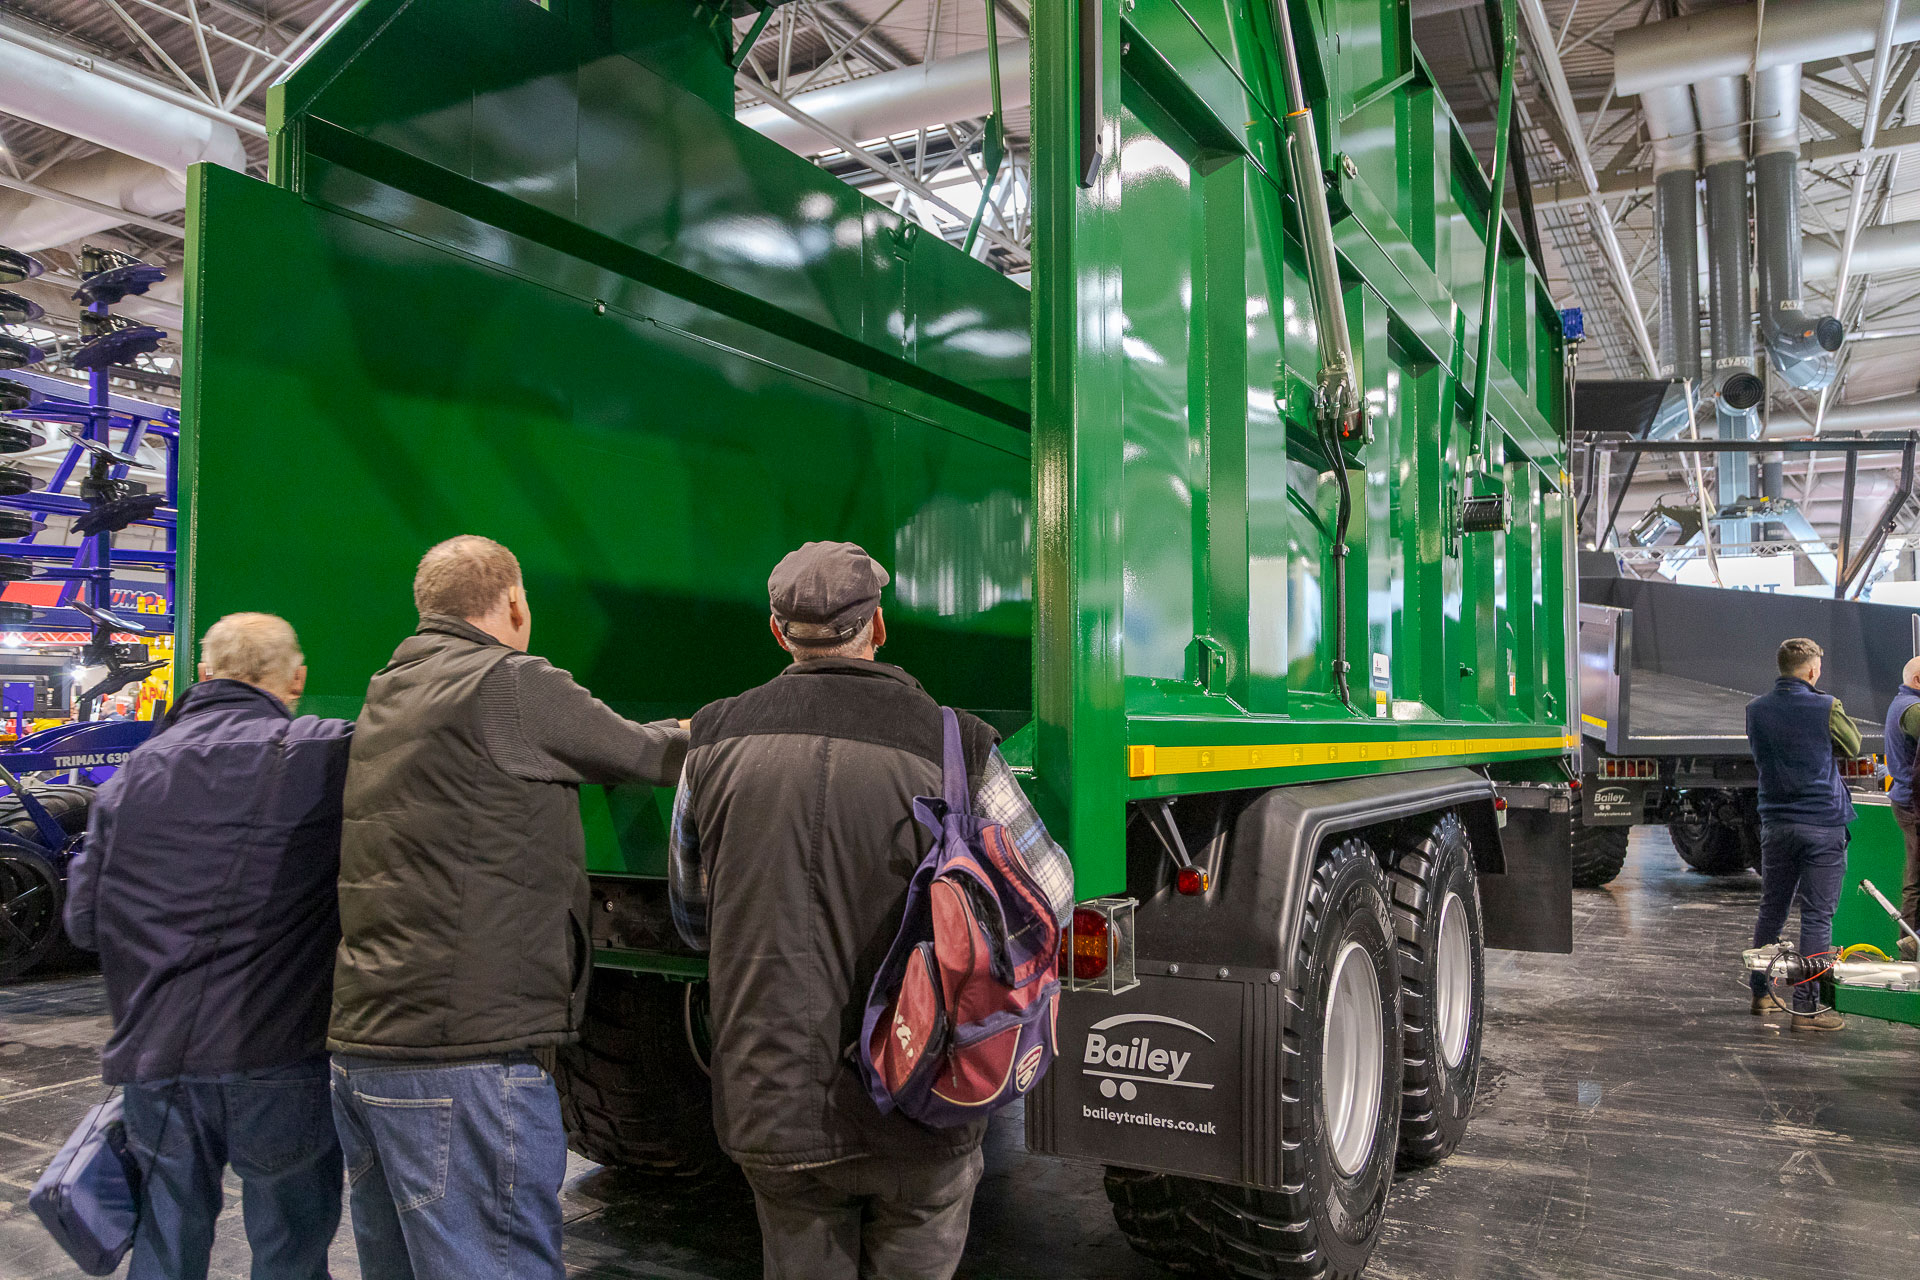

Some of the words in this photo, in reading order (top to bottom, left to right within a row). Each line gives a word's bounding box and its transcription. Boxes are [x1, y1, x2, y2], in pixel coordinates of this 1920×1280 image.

[54, 753, 105, 767] TRIMAX
[1594, 793, 1624, 804] Bailey
[1084, 1033, 1191, 1081] Bailey
[1083, 1105, 1216, 1134] baileytrailers.co.uk
